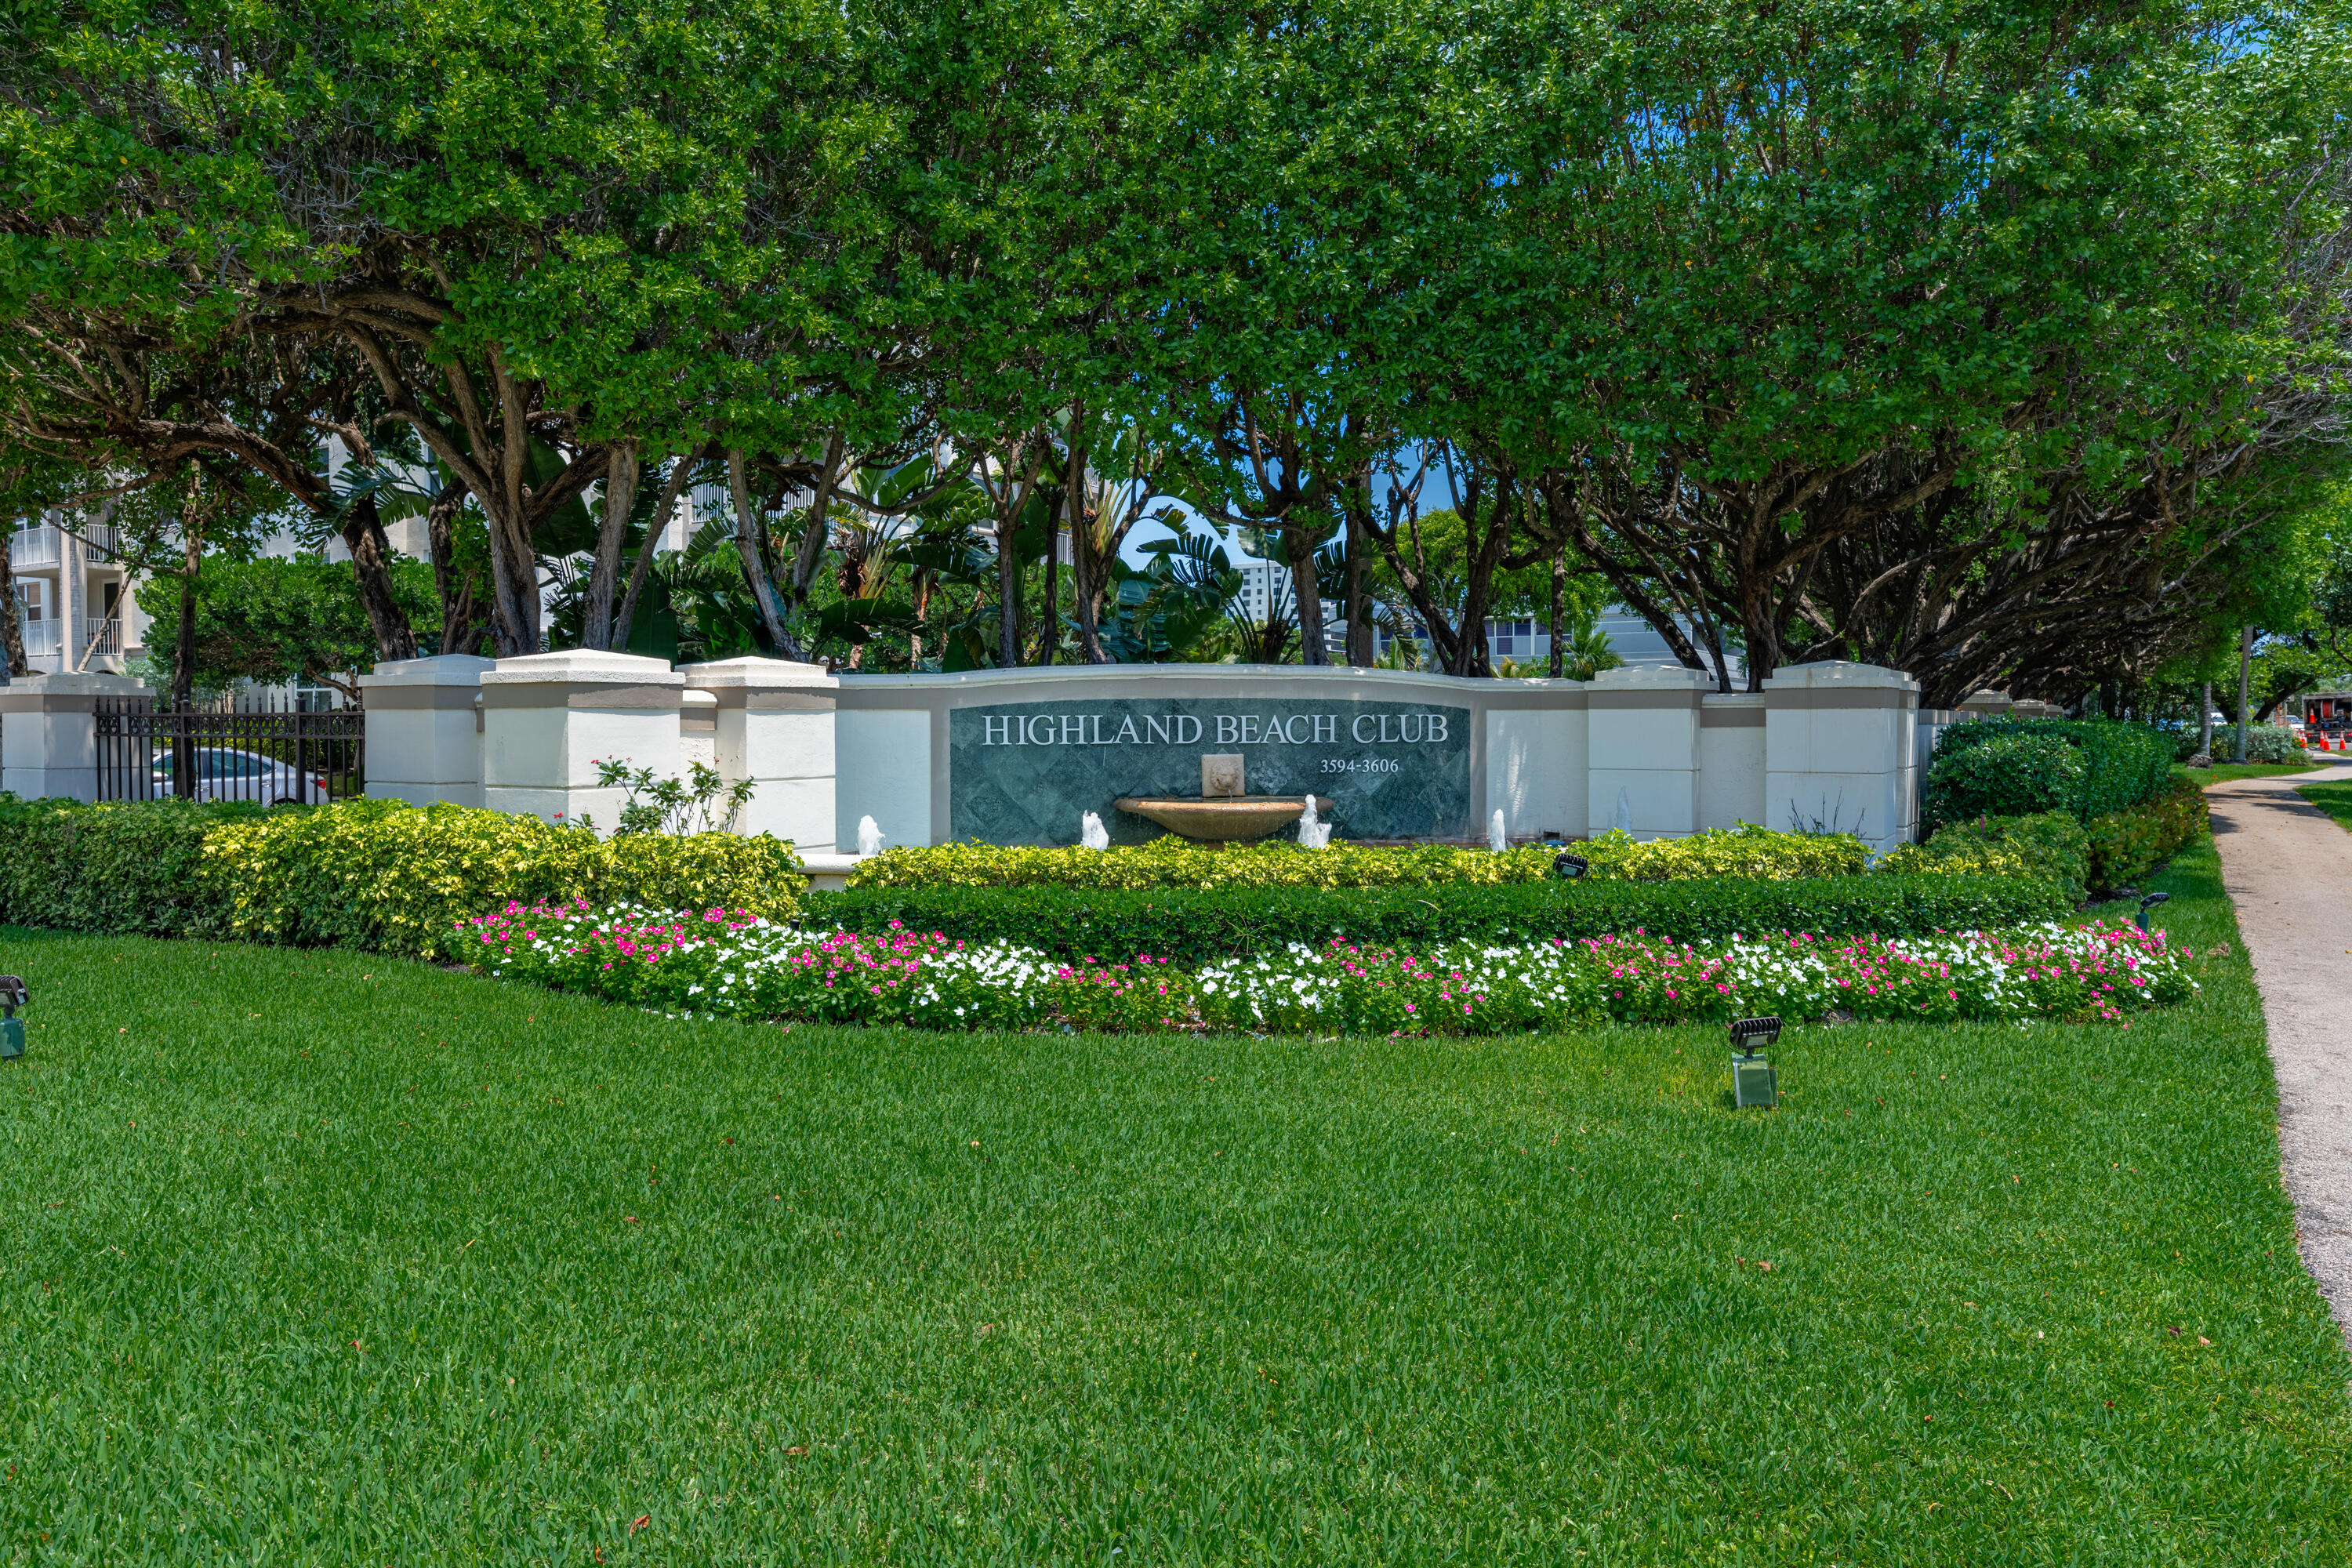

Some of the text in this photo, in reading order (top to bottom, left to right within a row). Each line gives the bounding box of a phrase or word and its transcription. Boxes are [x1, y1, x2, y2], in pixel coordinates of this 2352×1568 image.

[982, 713, 1449, 746] HIGHLAND BEACH CLUB
[1320, 758, 1399, 774] 3594-3606
